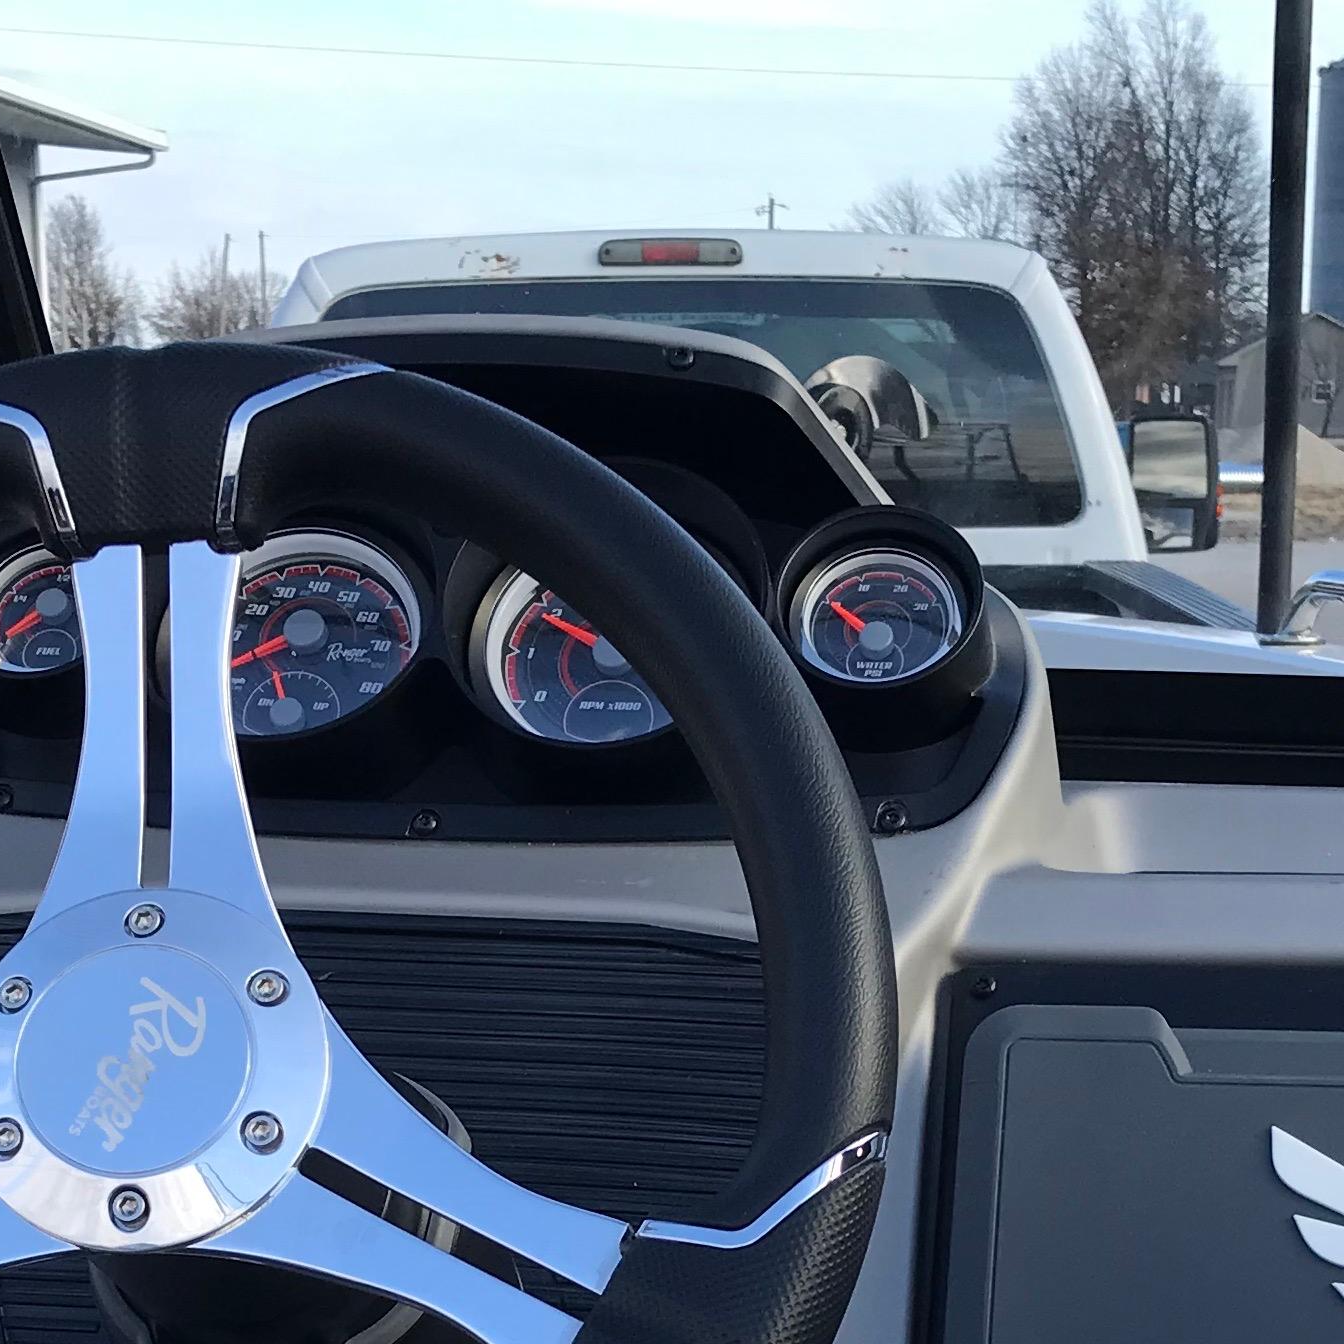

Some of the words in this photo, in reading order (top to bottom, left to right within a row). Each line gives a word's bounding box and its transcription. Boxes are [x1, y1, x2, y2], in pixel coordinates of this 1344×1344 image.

[272, 586, 296, 599] 30
[308, 581, 331, 593] 40
[858, 584, 870, 592] 10
[893, 584, 908, 593] 20
[336, 590, 360, 603] 50
[245, 603, 269, 615] 20
[912, 603, 928, 611] 30
[356, 611, 380, 623] 60
[35, 647, 61, 656] FUEL
[370, 639, 392, 652] 70
[527, 647, 535, 660] 1
[856, 661, 893, 670] WATER
[863, 670, 883, 678] PSI
[359, 681, 384, 694] 80
[533, 690, 548, 702] 0
[312, 702, 329, 710] UP
[578, 701, 604, 710] RPM
[607, 701, 642, 711] x1000
[100, 975, 207, 1153] Ranger
